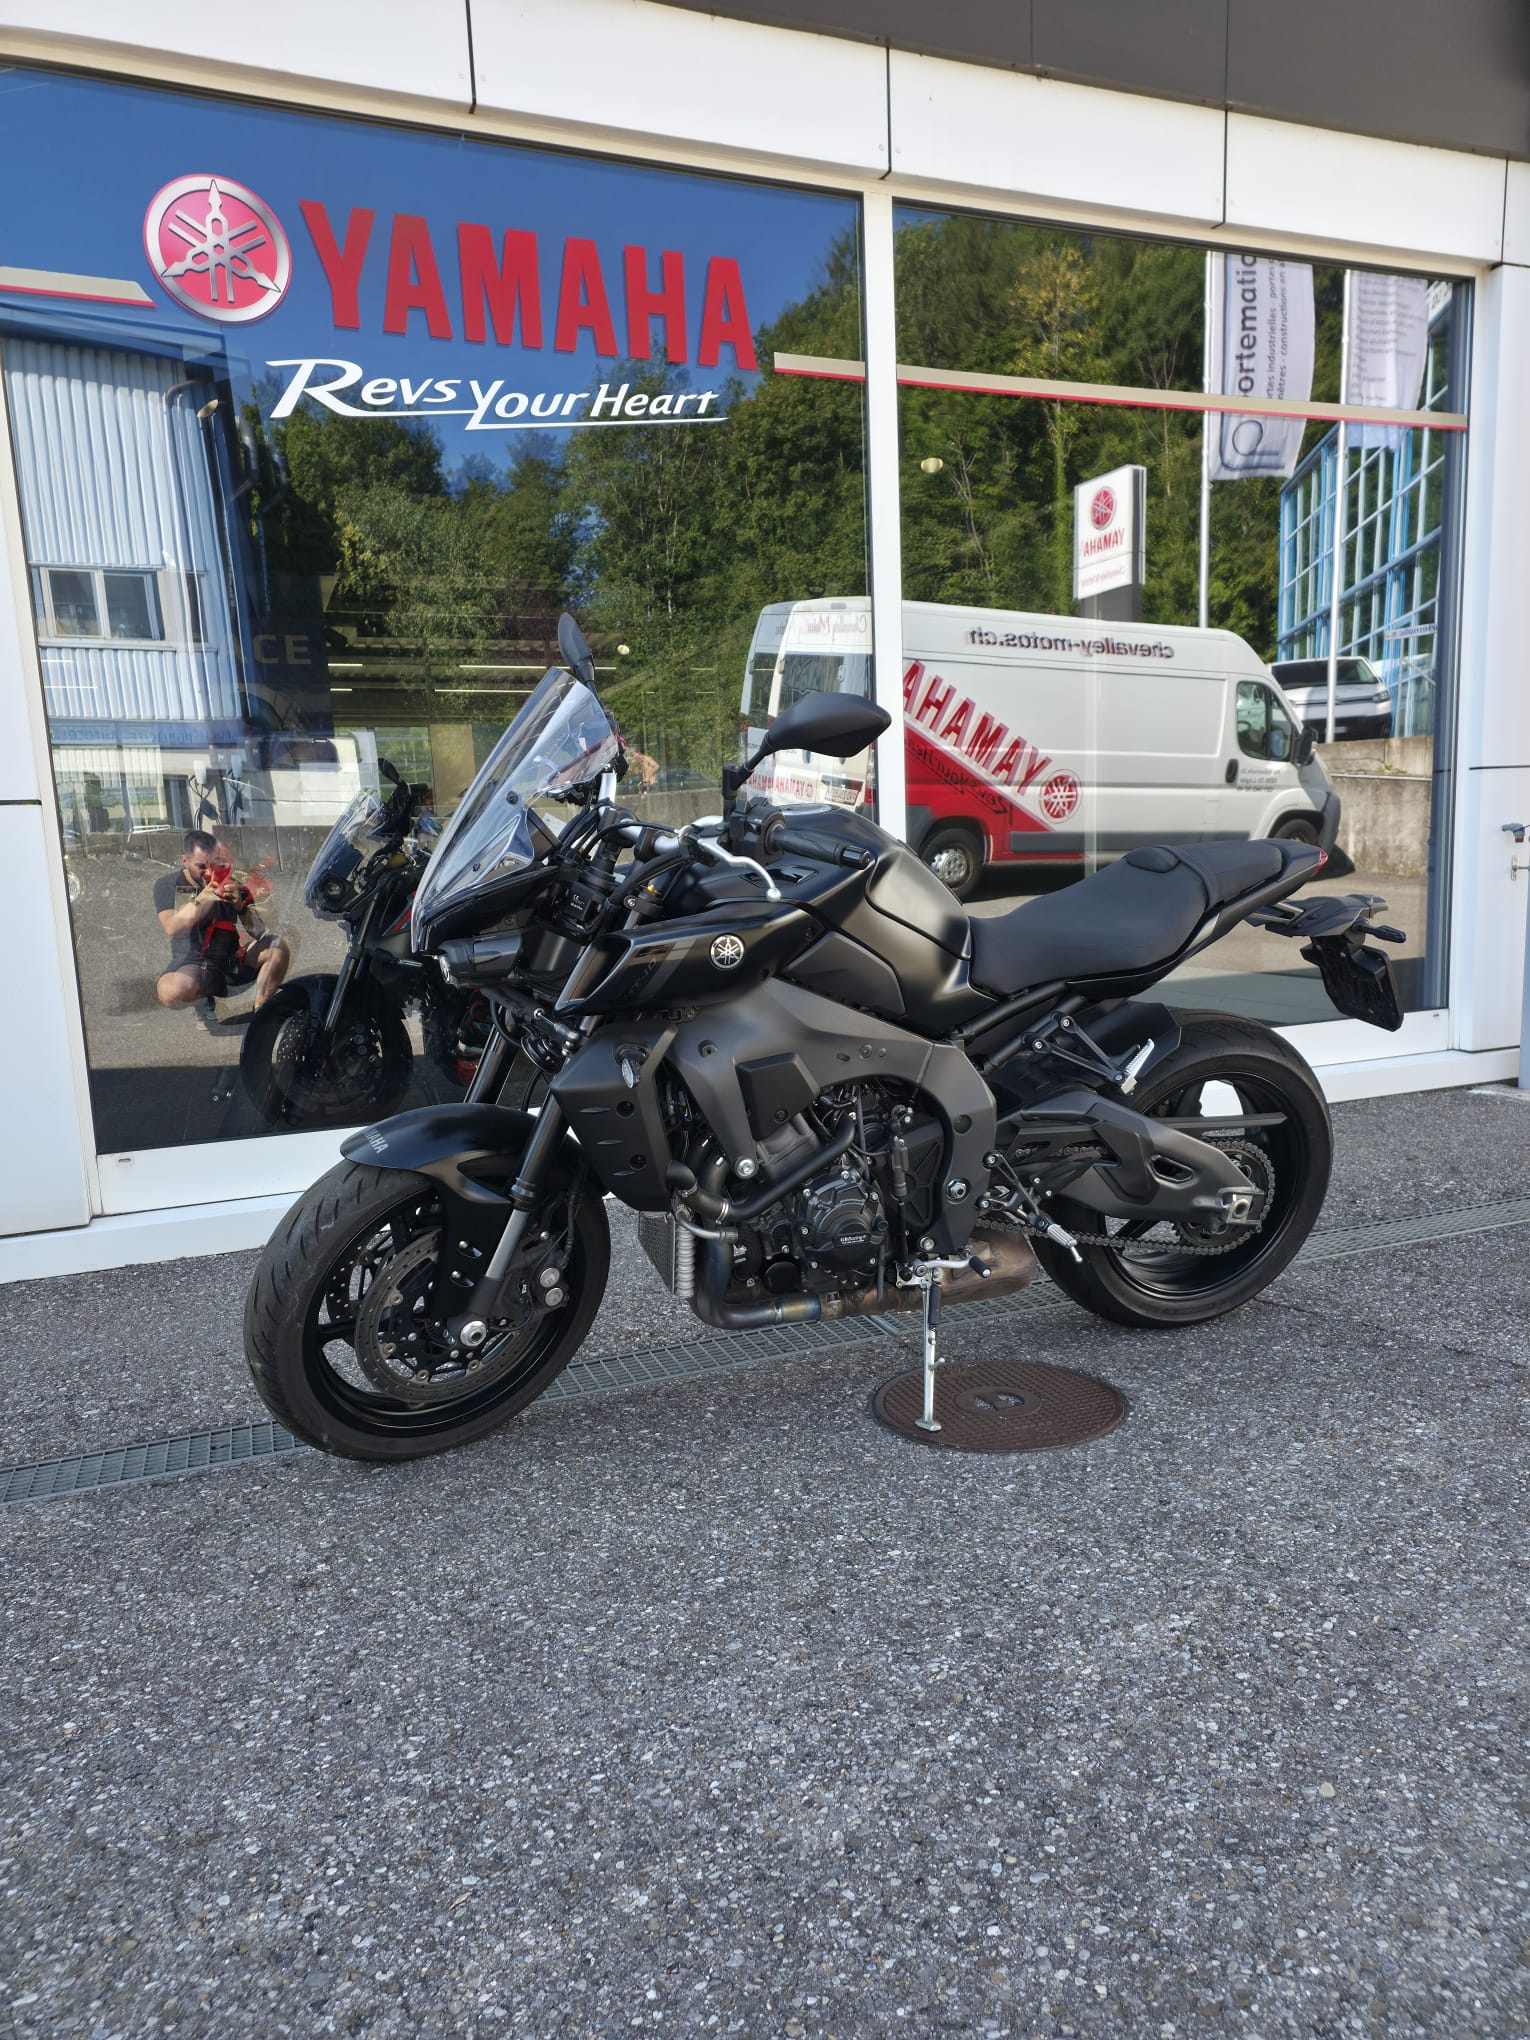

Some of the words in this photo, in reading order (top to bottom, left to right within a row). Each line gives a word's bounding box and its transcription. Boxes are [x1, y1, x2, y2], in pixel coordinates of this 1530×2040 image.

[300, 199, 758, 371] YAMAHA
[1235, 255, 1257, 398] ortematic
[265, 358, 462, 420] Revs
[464, 380, 589, 431] Your
[590, 383, 721, 417] Heart
